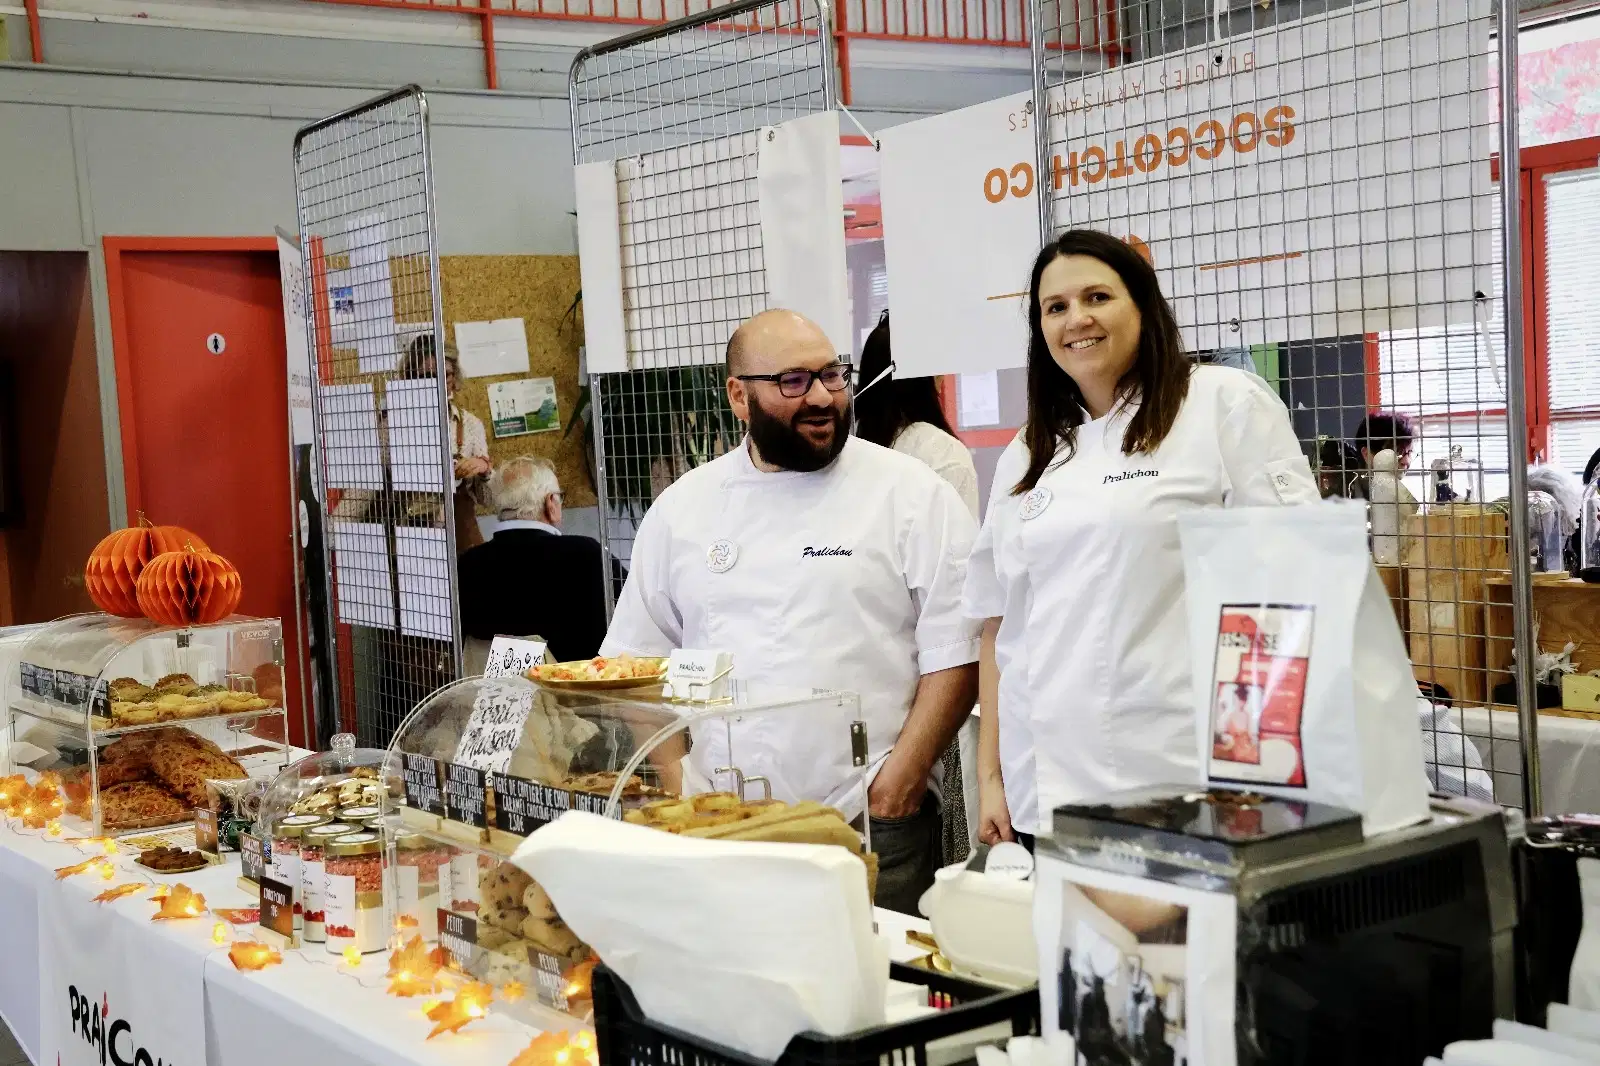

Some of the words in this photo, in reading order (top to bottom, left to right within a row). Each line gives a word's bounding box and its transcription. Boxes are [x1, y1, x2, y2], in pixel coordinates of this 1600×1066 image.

[1053, 105, 1296, 189] SOCCOTCH
[983, 162, 1034, 203] CO
[1102, 469, 1159, 485] Pralichou
[801, 545, 853, 558] Pralichou
